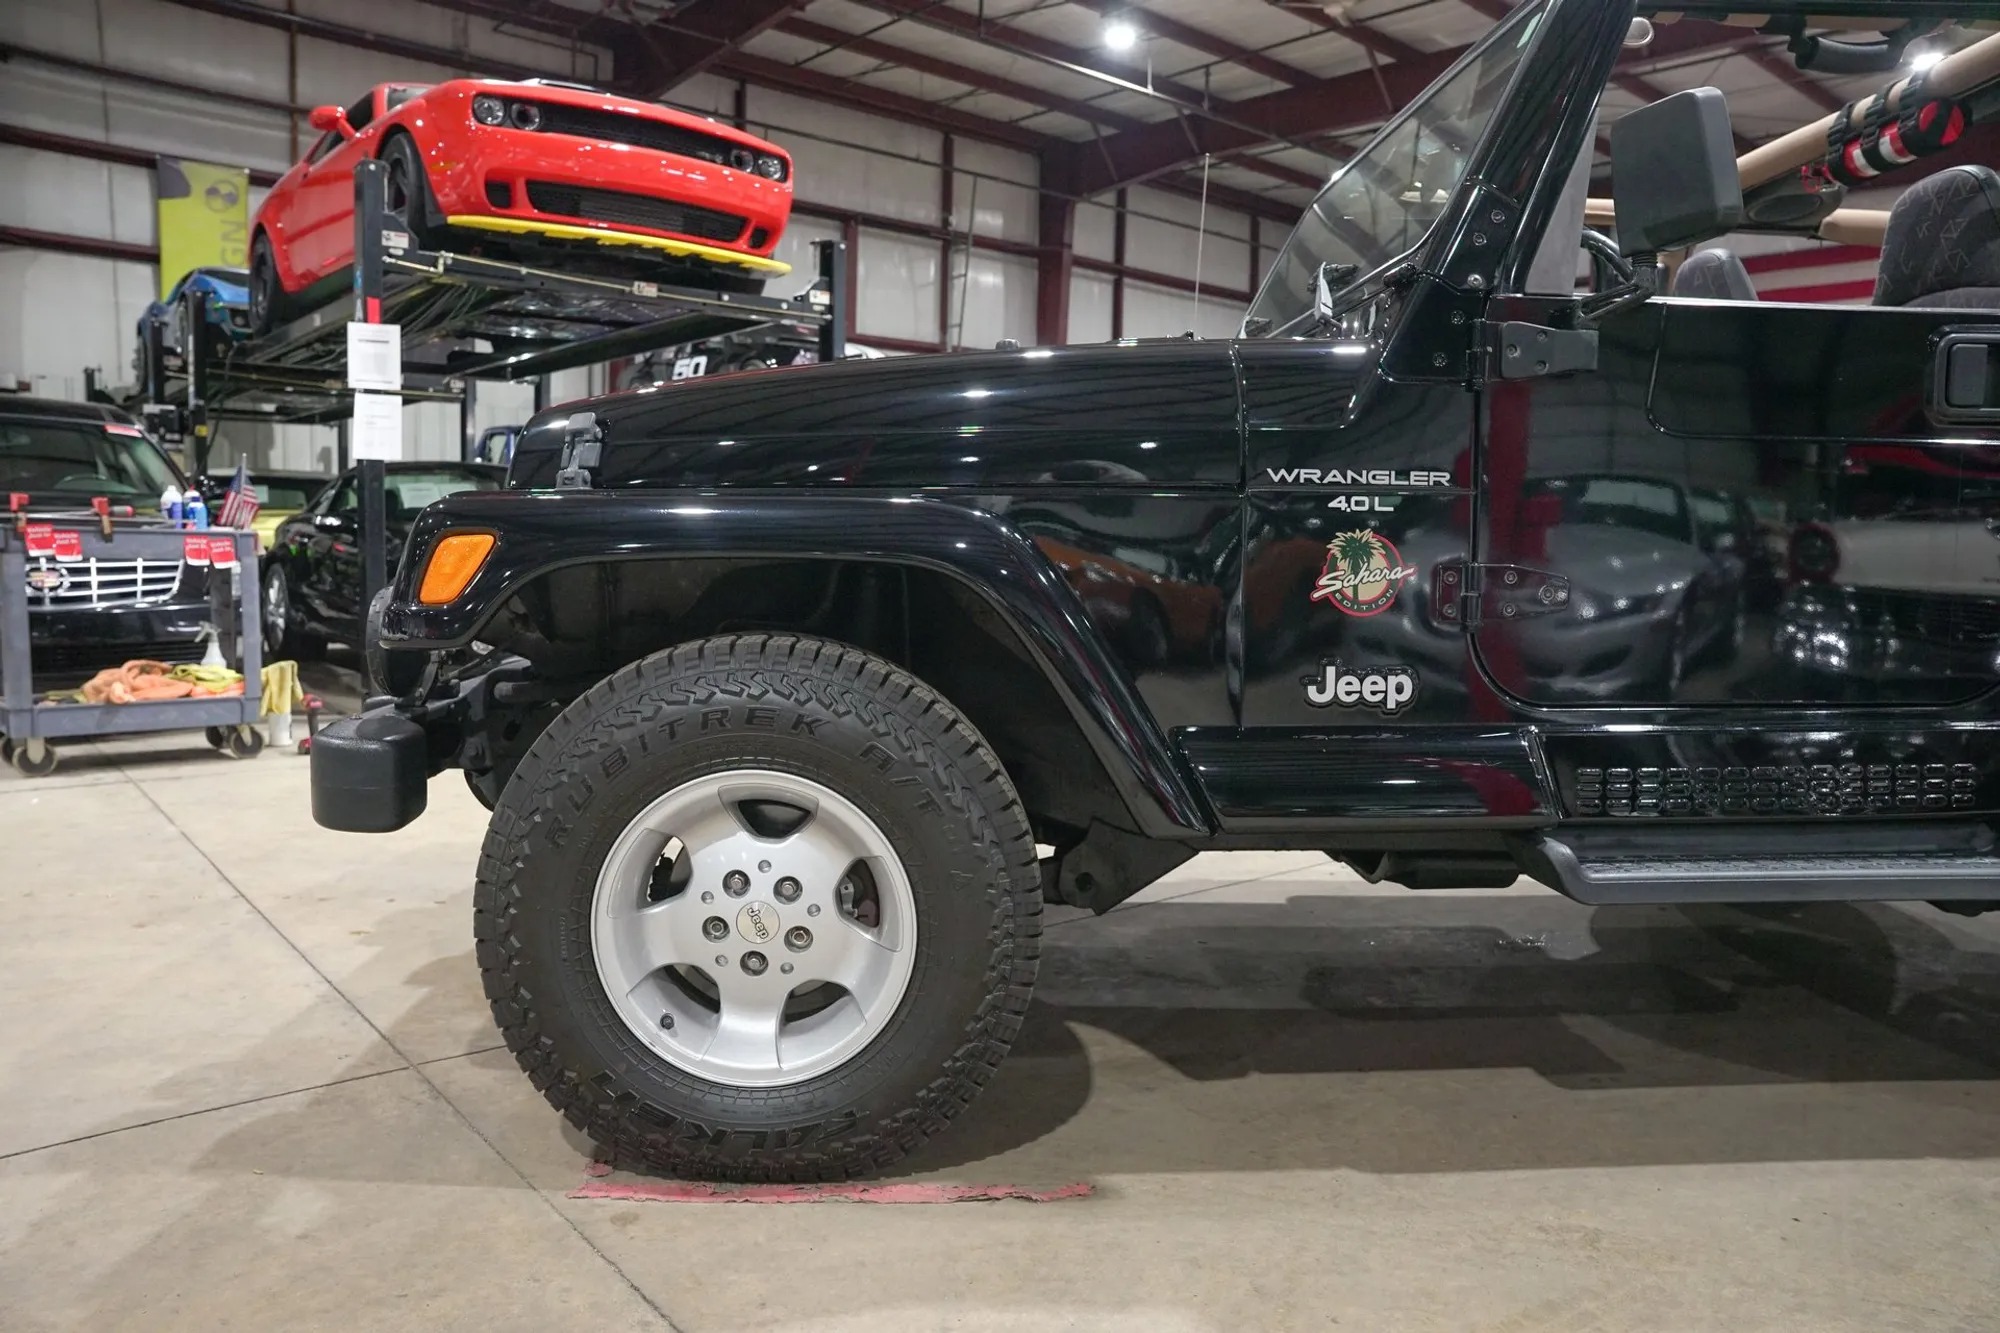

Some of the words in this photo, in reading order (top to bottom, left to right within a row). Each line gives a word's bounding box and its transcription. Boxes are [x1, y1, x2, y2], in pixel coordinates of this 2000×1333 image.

[1266, 467, 1452, 487] WRANGLER
[1312, 562, 1415, 599] Sahara
[1335, 588, 1394, 611] EDITION
[1307, 665, 1414, 709] Jeep
[544, 705, 832, 850] RUBITREK
[746, 906, 769, 940] Jeep
